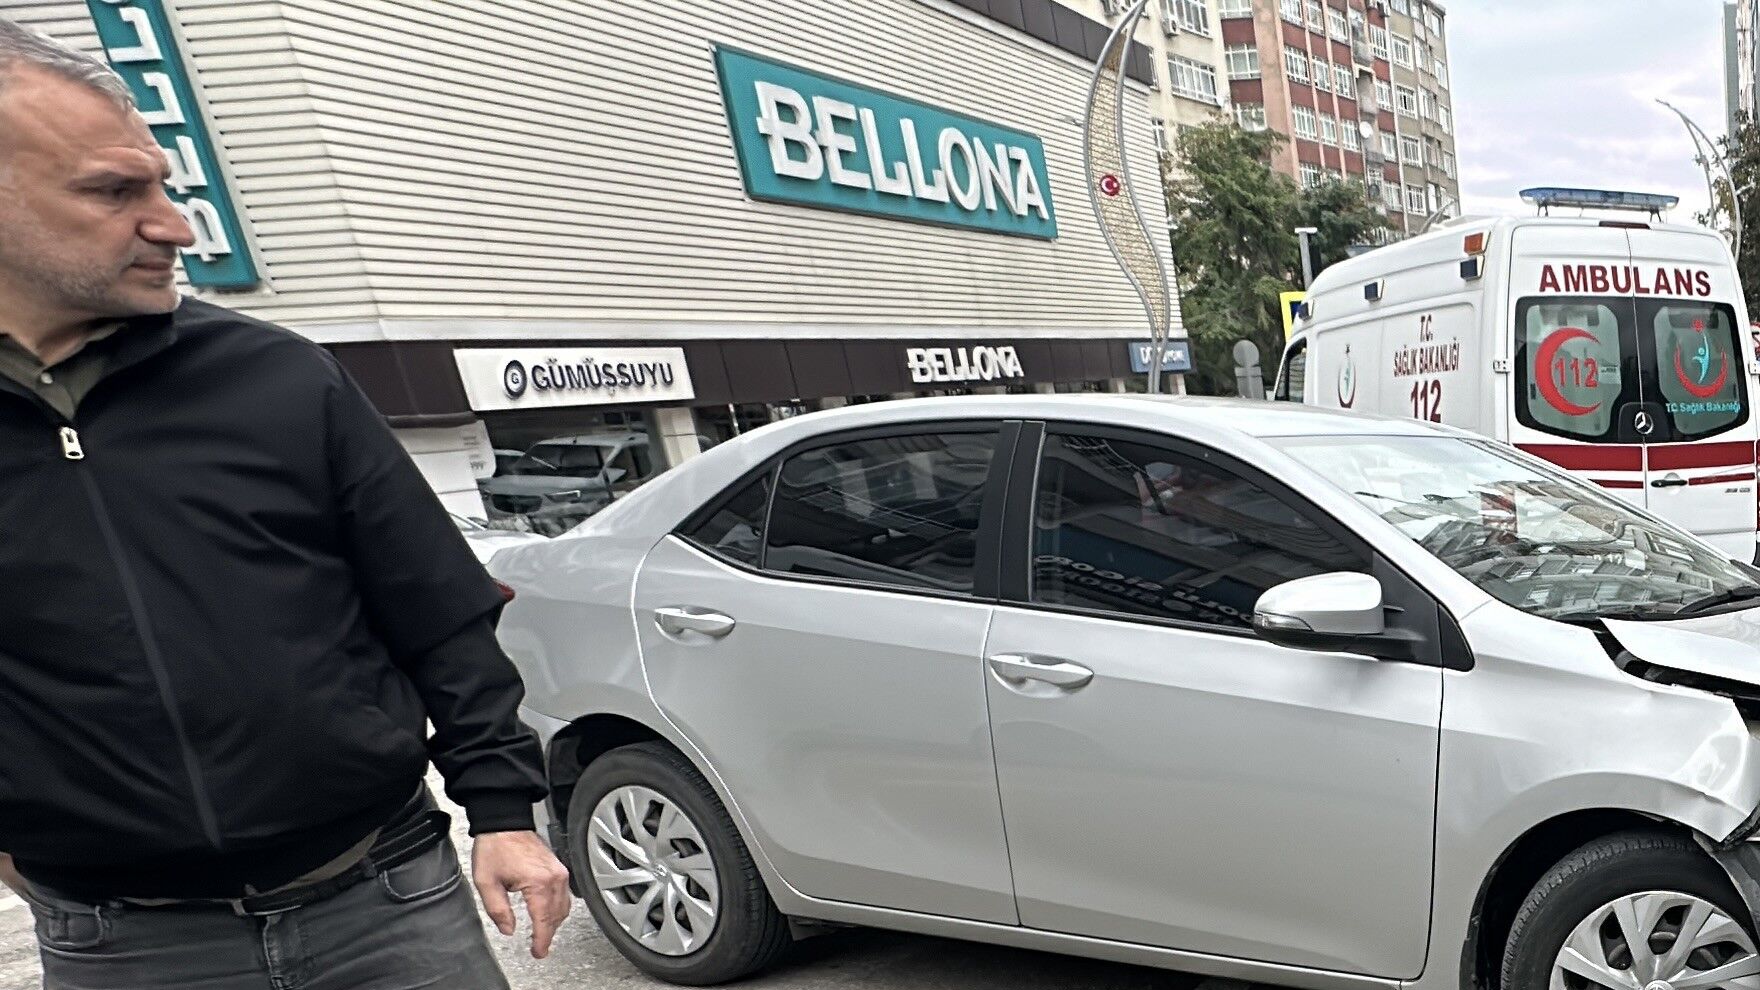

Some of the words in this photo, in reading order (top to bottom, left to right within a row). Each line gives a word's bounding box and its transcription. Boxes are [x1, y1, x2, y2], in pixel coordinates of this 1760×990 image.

[755, 81, 1049, 220] BELLONA
[1539, 264, 1712, 297] AMBULANS
[531, 357, 674, 397] GÜMÜŞSUYU
[906, 346, 1025, 383] BELLONA
[1555, 357, 1599, 388] 112
[1410, 379, 1442, 424] 112
